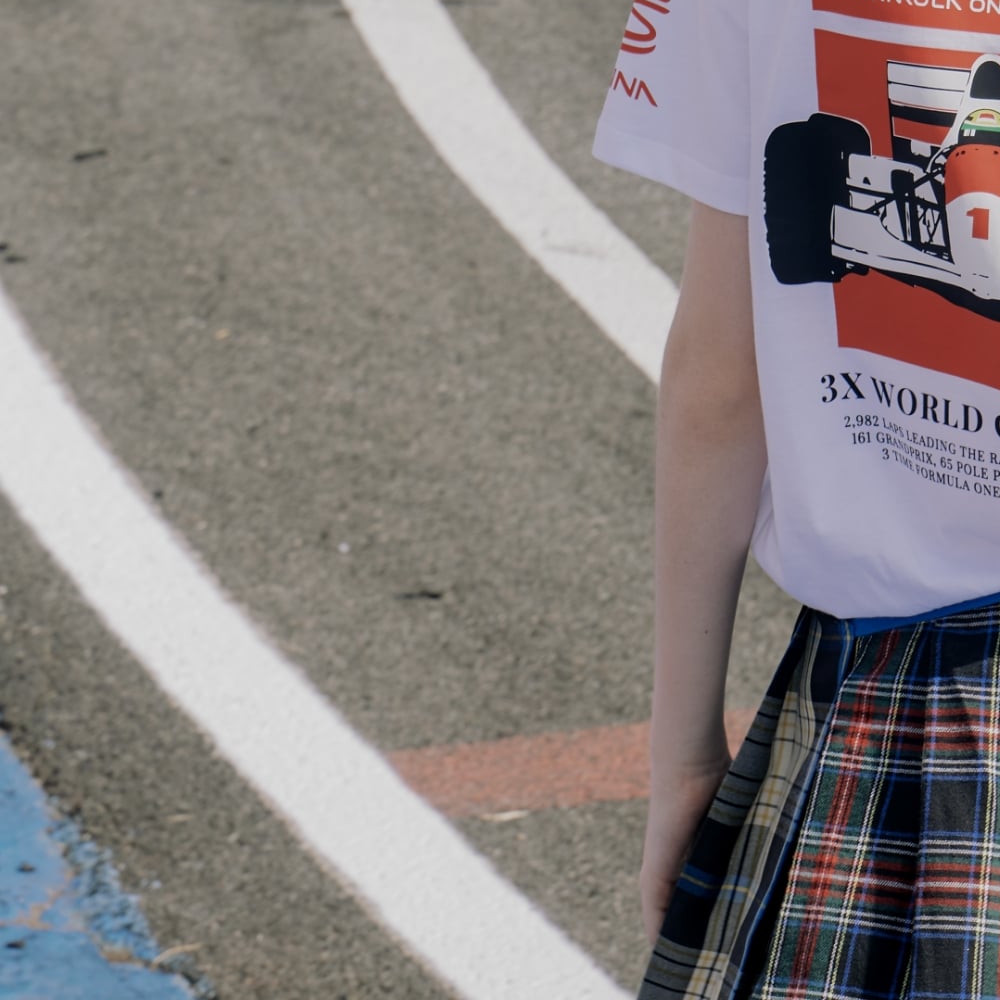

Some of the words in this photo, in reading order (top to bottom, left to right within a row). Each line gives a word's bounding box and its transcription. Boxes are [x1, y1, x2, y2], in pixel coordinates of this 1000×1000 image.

[966, 207, 990, 241] 1
[820, 372, 866, 403] 3X
[870, 376, 983, 433] WORLD
[843, 414, 880, 429] 2,982
[882, 417, 904, 438] LAPS
[906, 430, 957, 455] LEADING
[959, 445, 985, 463] THE
[851, 431, 872, 445] 161
[940, 456, 953, 471] 65
[956, 461, 988, 480] POLE
[881, 447, 890, 461] 3
[892, 449, 915, 472] TIME
[914, 465, 970, 492] FORMULA
[973, 481, 1000, 499] ONE
